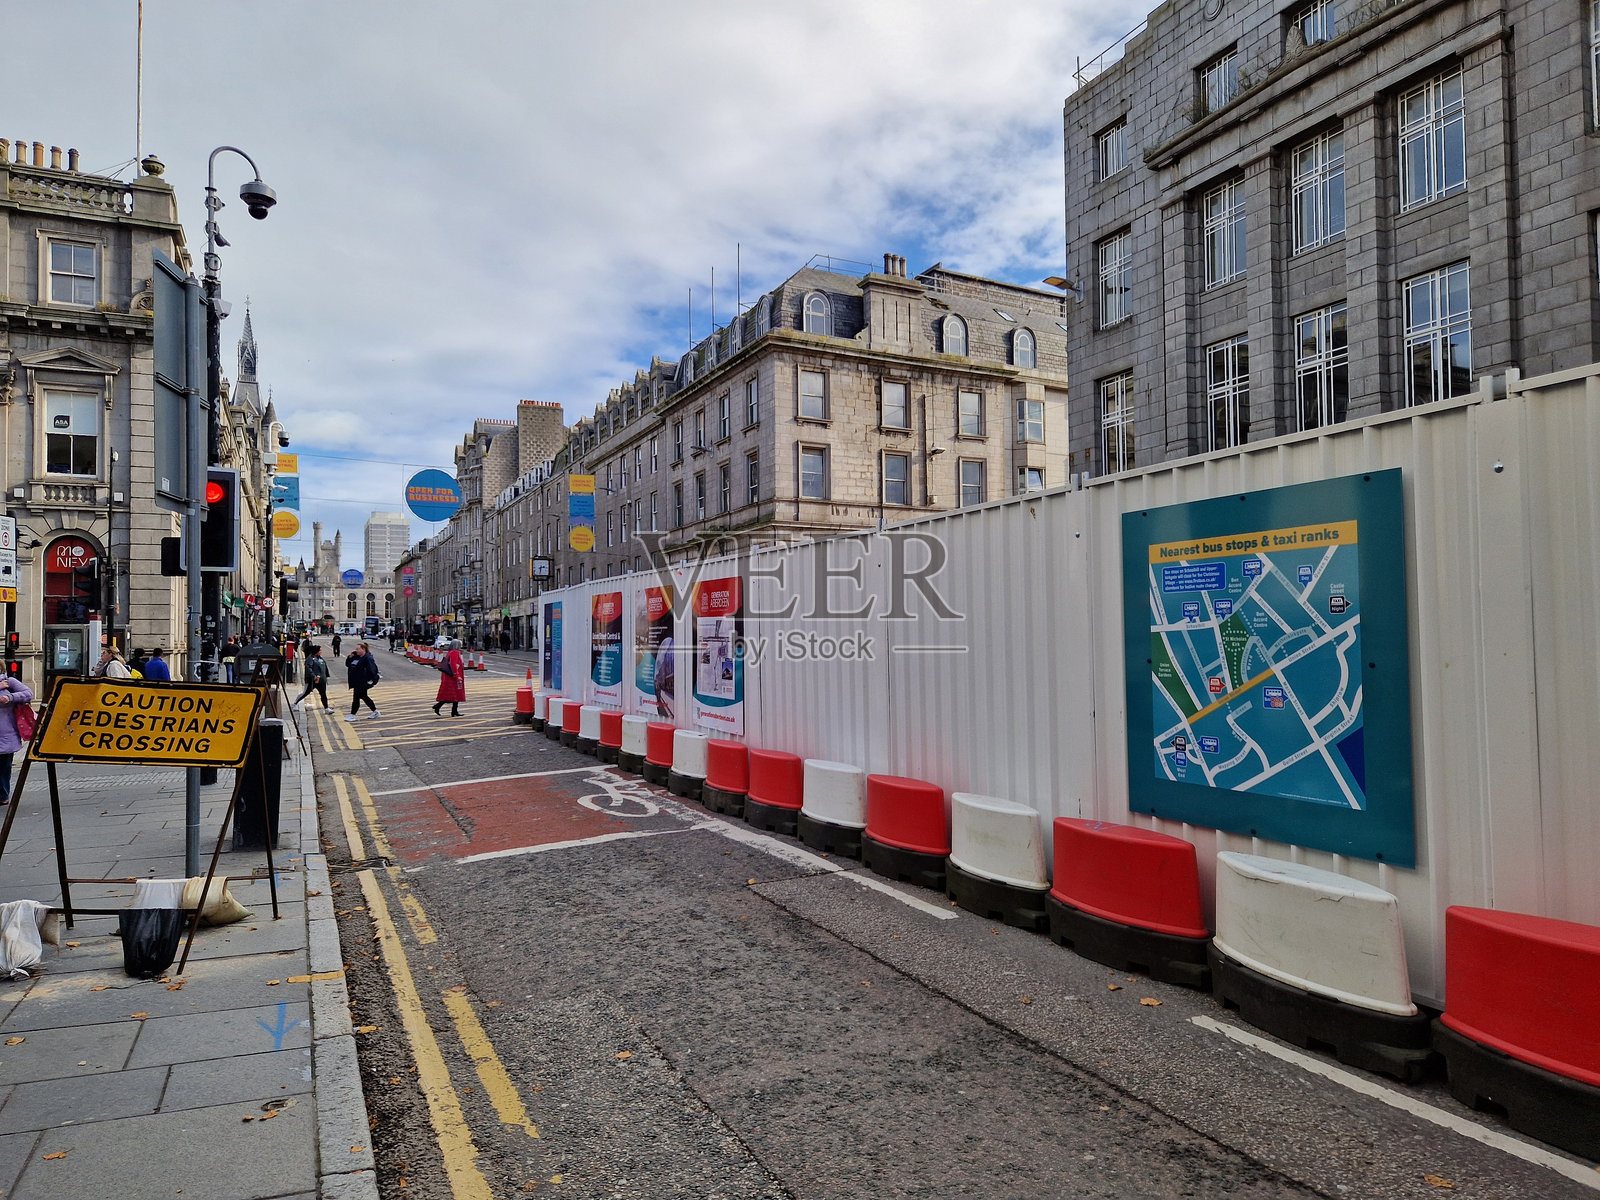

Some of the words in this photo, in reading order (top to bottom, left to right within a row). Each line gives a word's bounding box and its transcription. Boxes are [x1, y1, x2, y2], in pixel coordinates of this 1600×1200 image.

[1160, 544, 1200, 558] Nearest
[1202, 542, 1222, 553] bus
[1226, 538, 1258, 552] stops
[1261, 534, 1270, 547] &
[1273, 531, 1297, 545] taxi
[1301, 528, 1340, 542] ranks
[710, 598, 730, 608] ABERDEEN
[1288, 651, 1301, 662] Union
[1301, 642, 1316, 654] Street
[101, 691, 213, 714] CAUTION
[66, 710, 236, 734] PEDESTRIANS
[1324, 726, 1341, 741] Virginia
[1340, 714, 1355, 729] Street
[78, 732, 212, 754] CROSSING
[1282, 756, 1294, 766] Guild
[1294, 749, 1308, 759] Street
